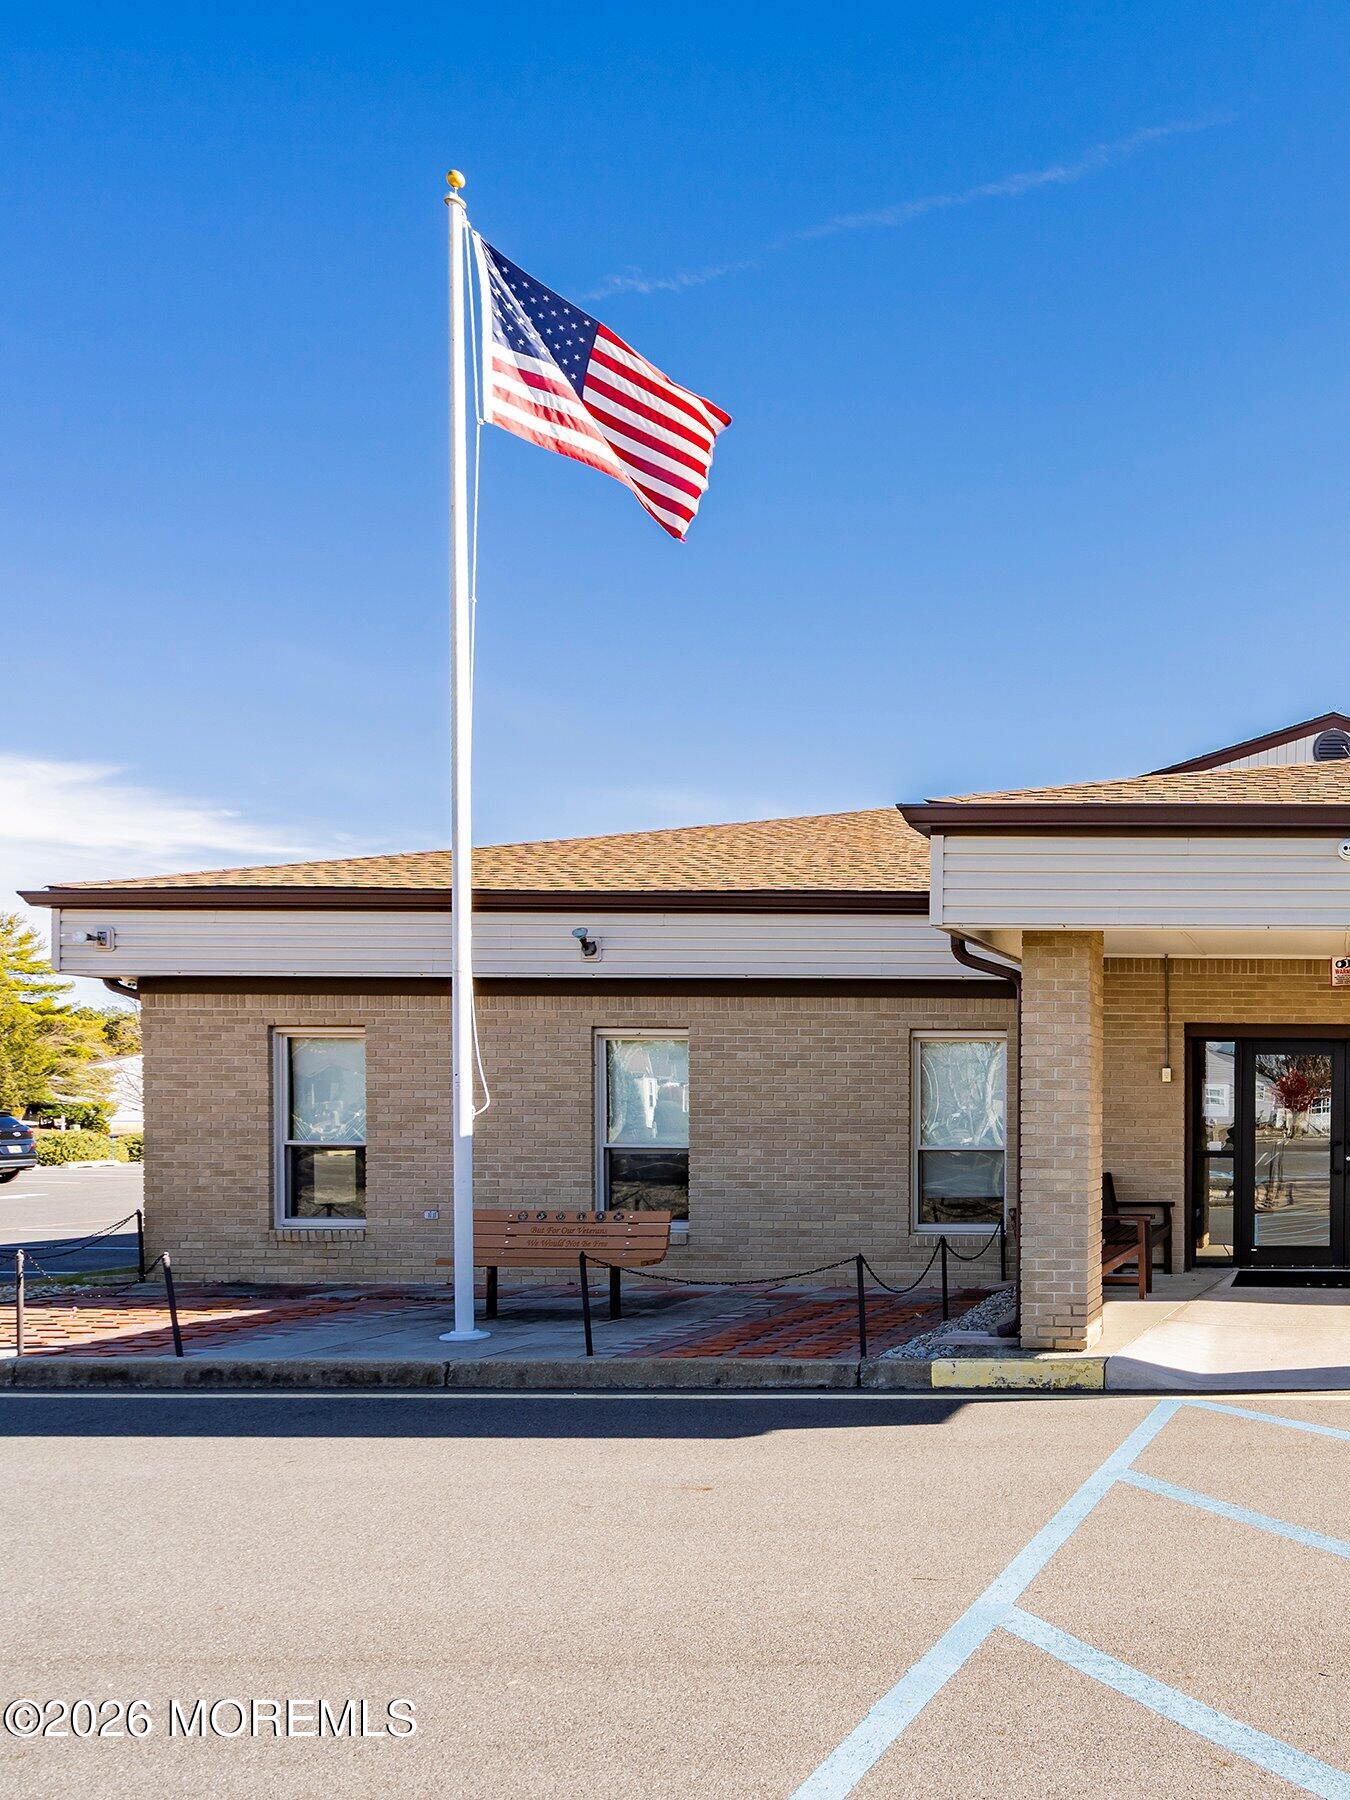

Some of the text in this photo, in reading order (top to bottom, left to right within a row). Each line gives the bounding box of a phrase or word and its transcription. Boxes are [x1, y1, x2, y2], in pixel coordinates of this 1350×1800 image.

[530, 1226, 608, 1234] But For Our Veterans
[527, 1239, 608, 1248] We Would Not Be Free
